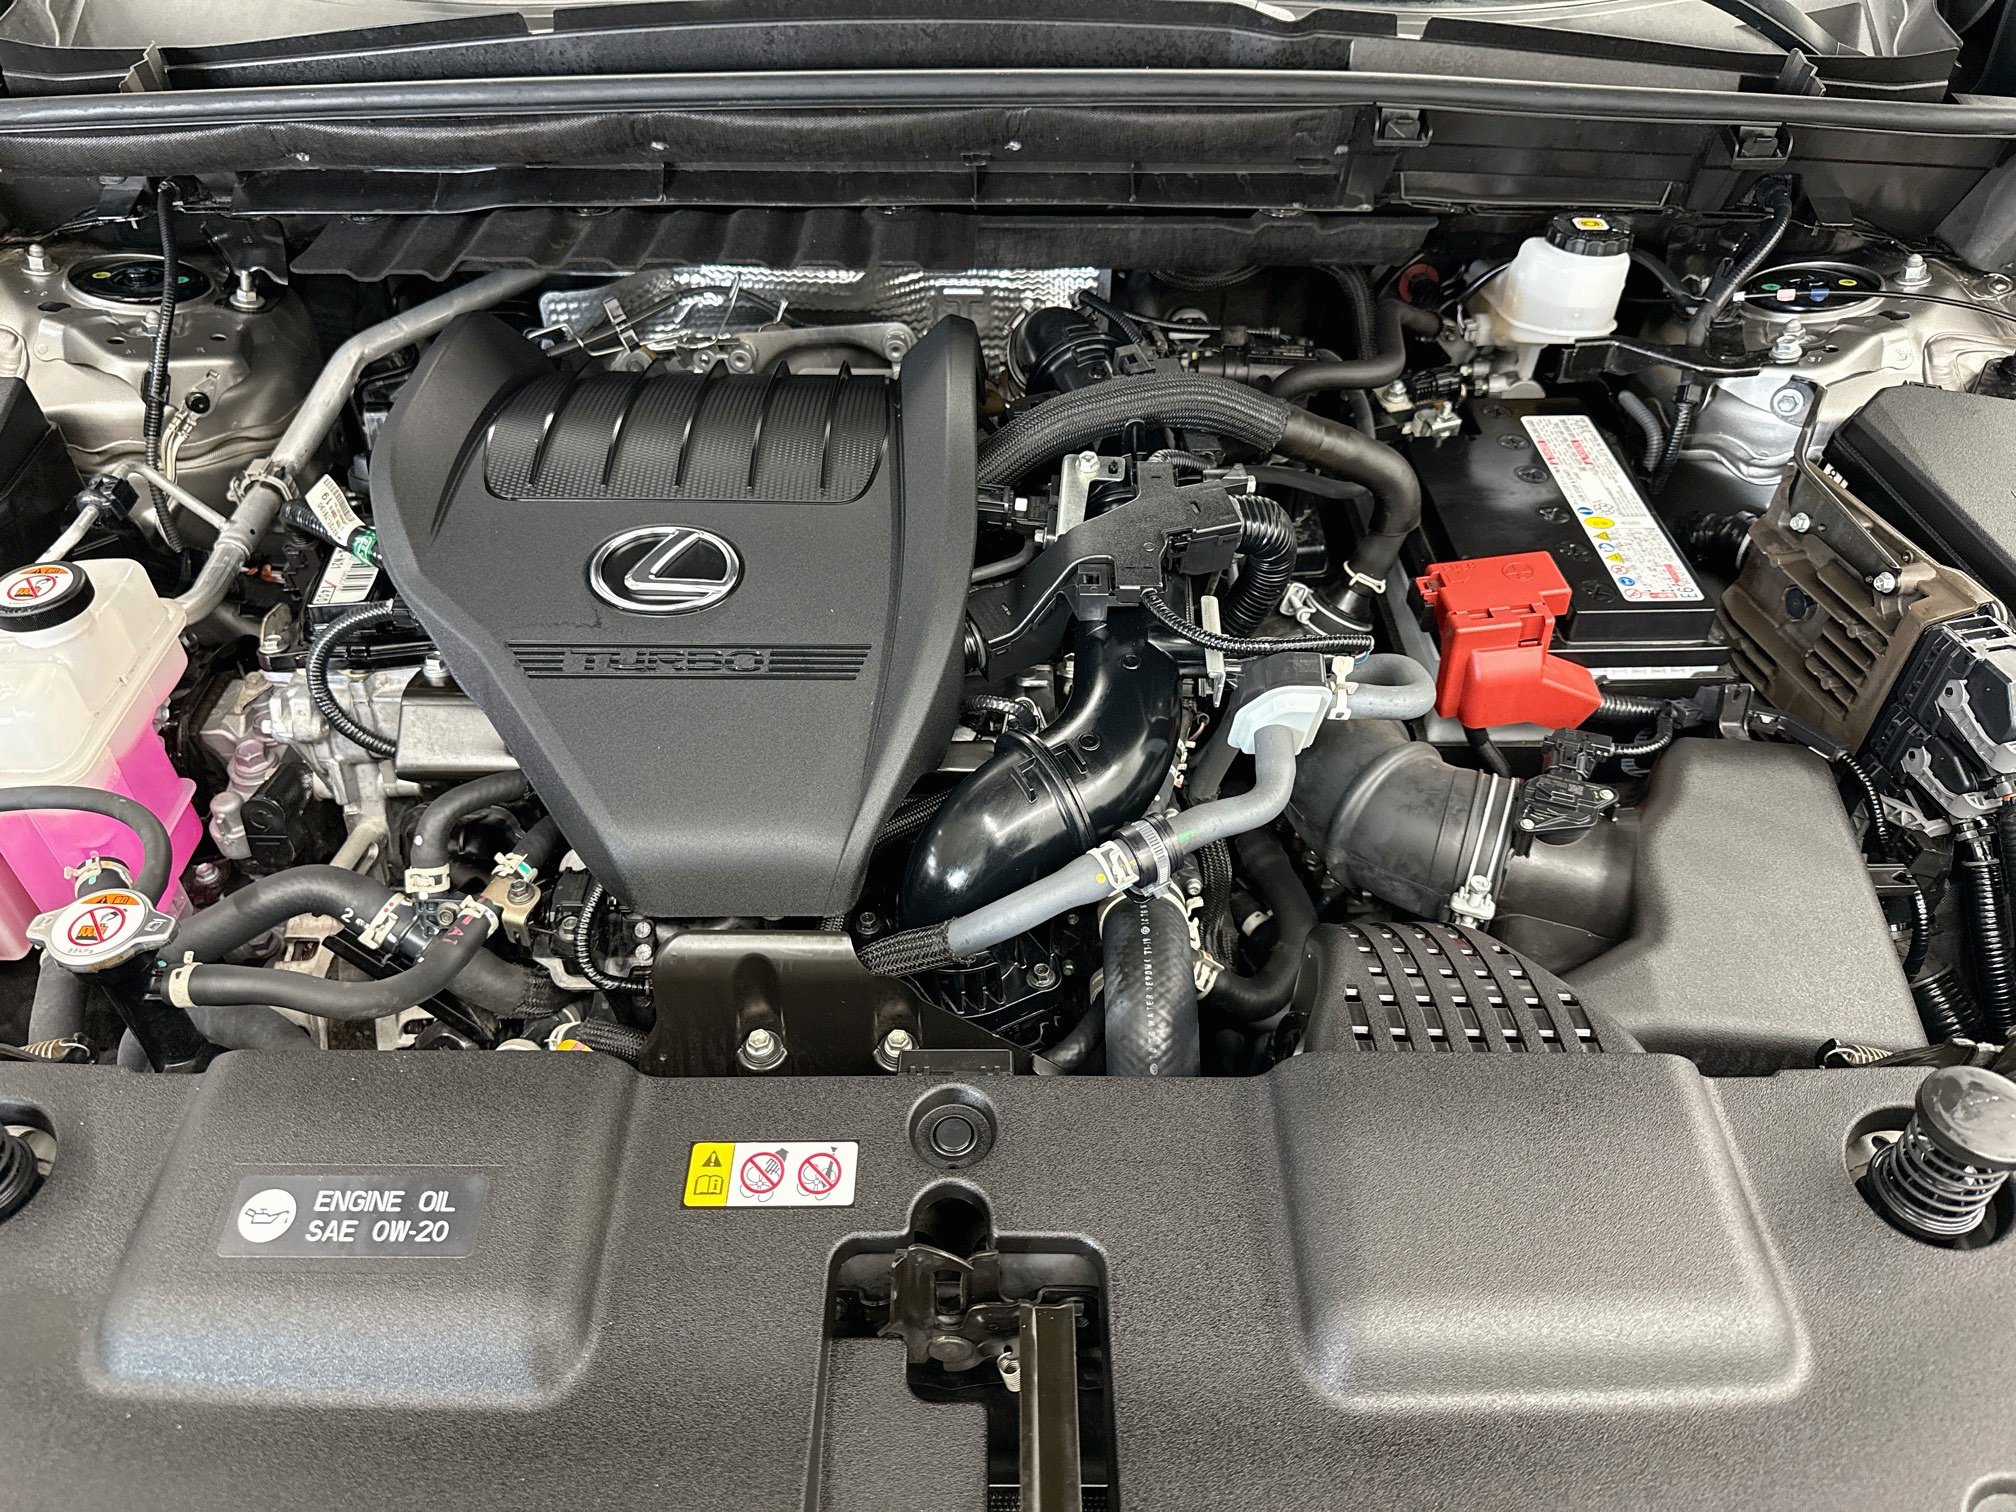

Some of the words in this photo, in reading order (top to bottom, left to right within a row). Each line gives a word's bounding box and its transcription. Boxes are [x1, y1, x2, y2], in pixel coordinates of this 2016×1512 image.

[570, 648, 765, 672] TURBO
[1145, 994, 1155, 1027] WATER
[313, 1190, 405, 1212] ENGINE
[418, 1190, 456, 1212] OIL
[305, 1220, 358, 1242] SAE
[372, 1220, 450, 1242] 0W-20
